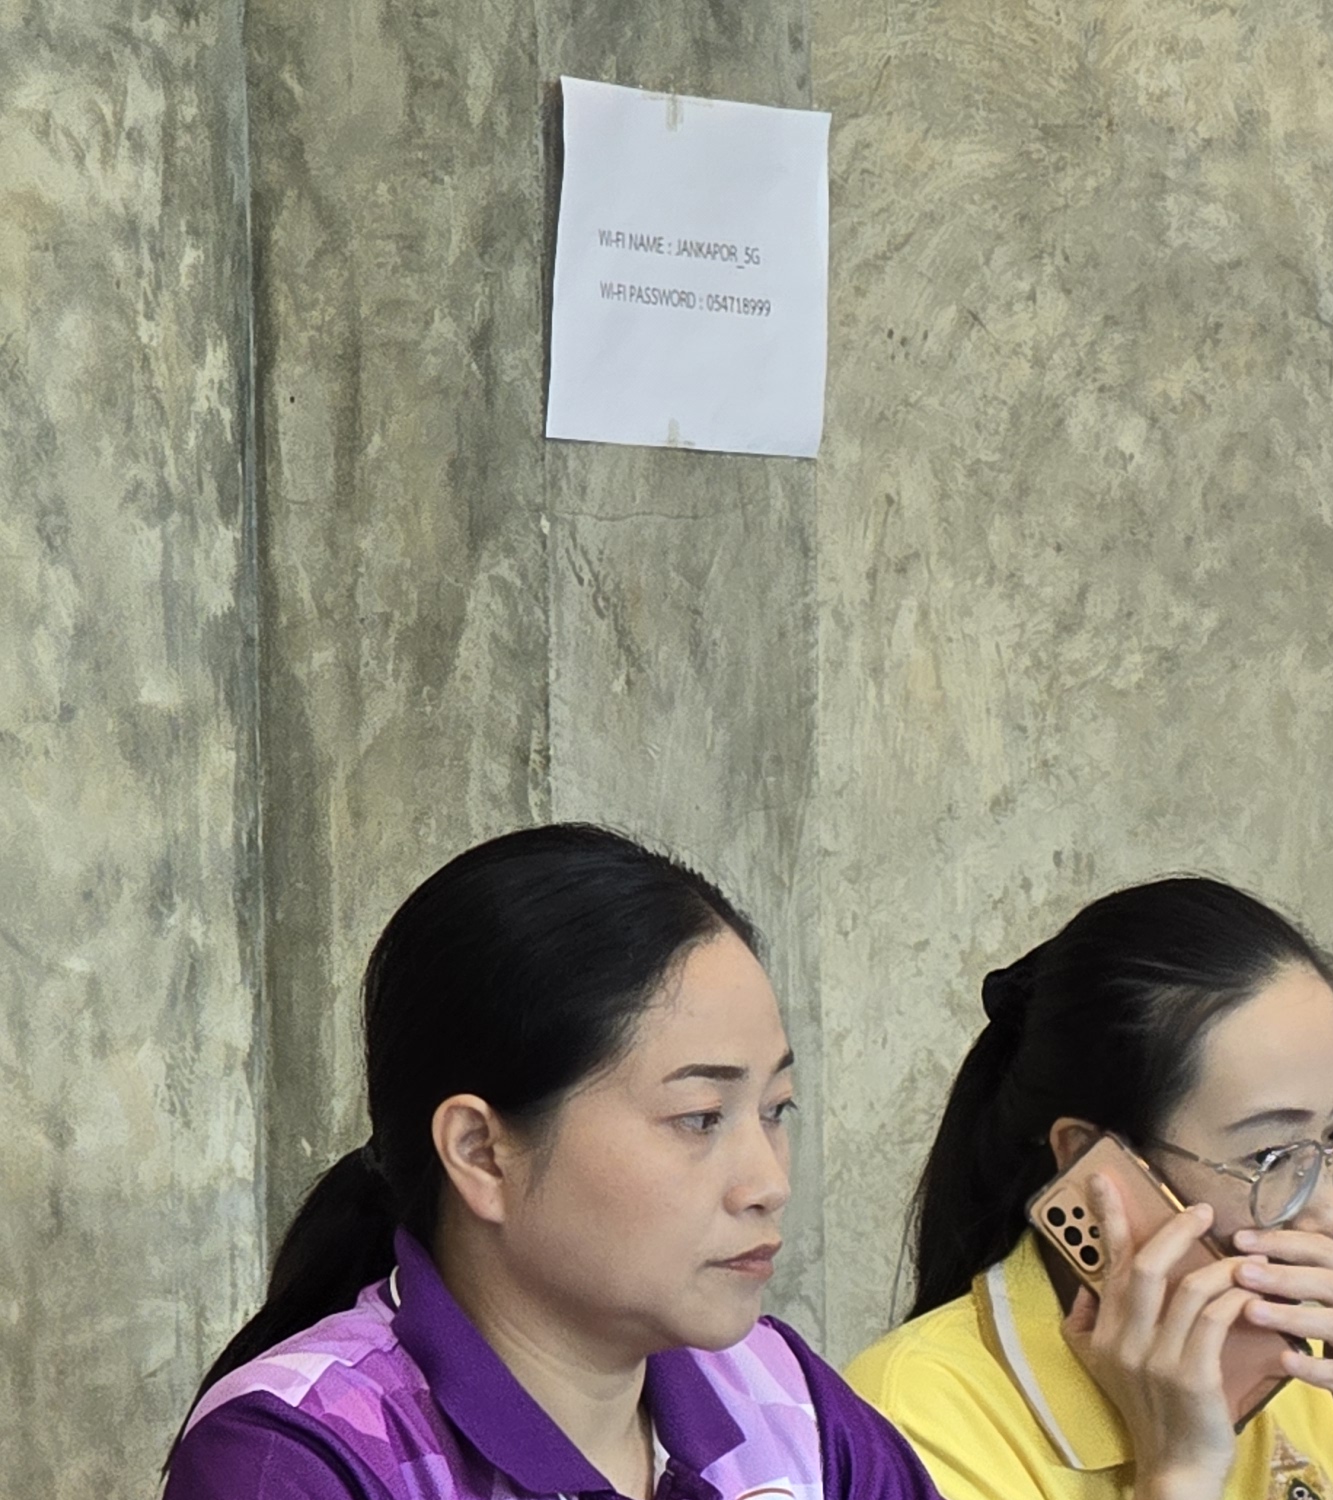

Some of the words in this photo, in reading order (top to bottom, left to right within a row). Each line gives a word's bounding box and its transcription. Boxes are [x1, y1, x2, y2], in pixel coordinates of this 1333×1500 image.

[598, 229, 625, 248] WI-FI
[629, 233, 664, 254] NAME
[675, 238, 760, 269] JANKAPOR_5G
[600, 281, 626, 301] WI-FI
[629, 284, 696, 309] PASSWORD
[706, 294, 771, 317] 054718999
